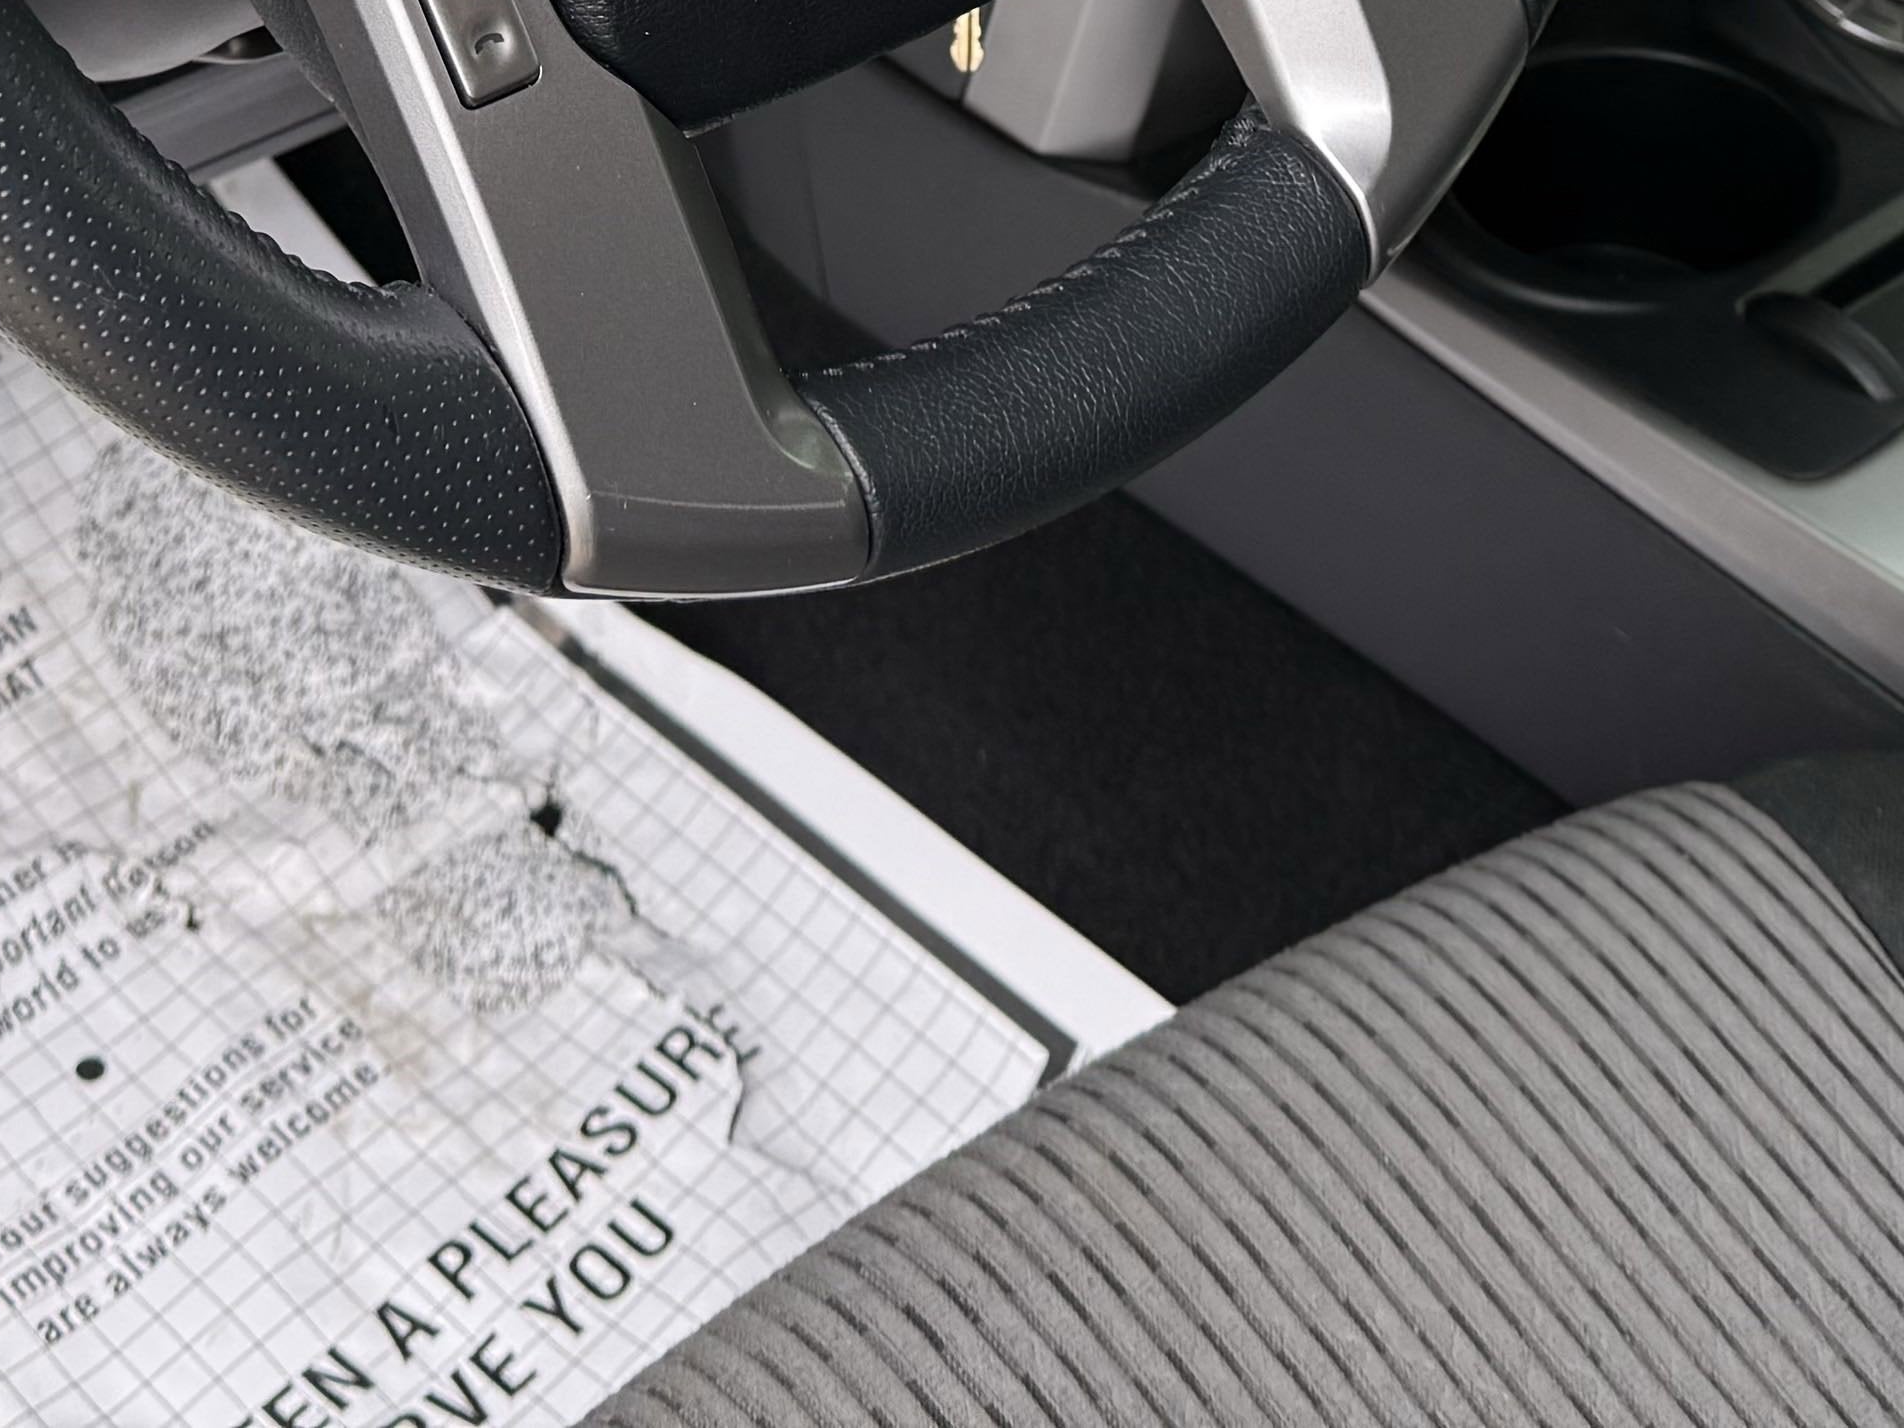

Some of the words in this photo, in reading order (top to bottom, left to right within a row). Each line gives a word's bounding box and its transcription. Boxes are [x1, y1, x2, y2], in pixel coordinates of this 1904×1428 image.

[81, 934, 122, 972] to
[63, 1031, 266, 1208] suggestions
[263, 994, 320, 1043] for
[179, 1109, 239, 1170] our
[240, 1015, 365, 1115] service
[376, 1298, 441, 1362] A
[427, 1003, 762, 1301] PLEASURE
[37, 1291, 101, 1346] are
[105, 1185, 228, 1298] always
[521, 1197, 677, 1337] YOU
